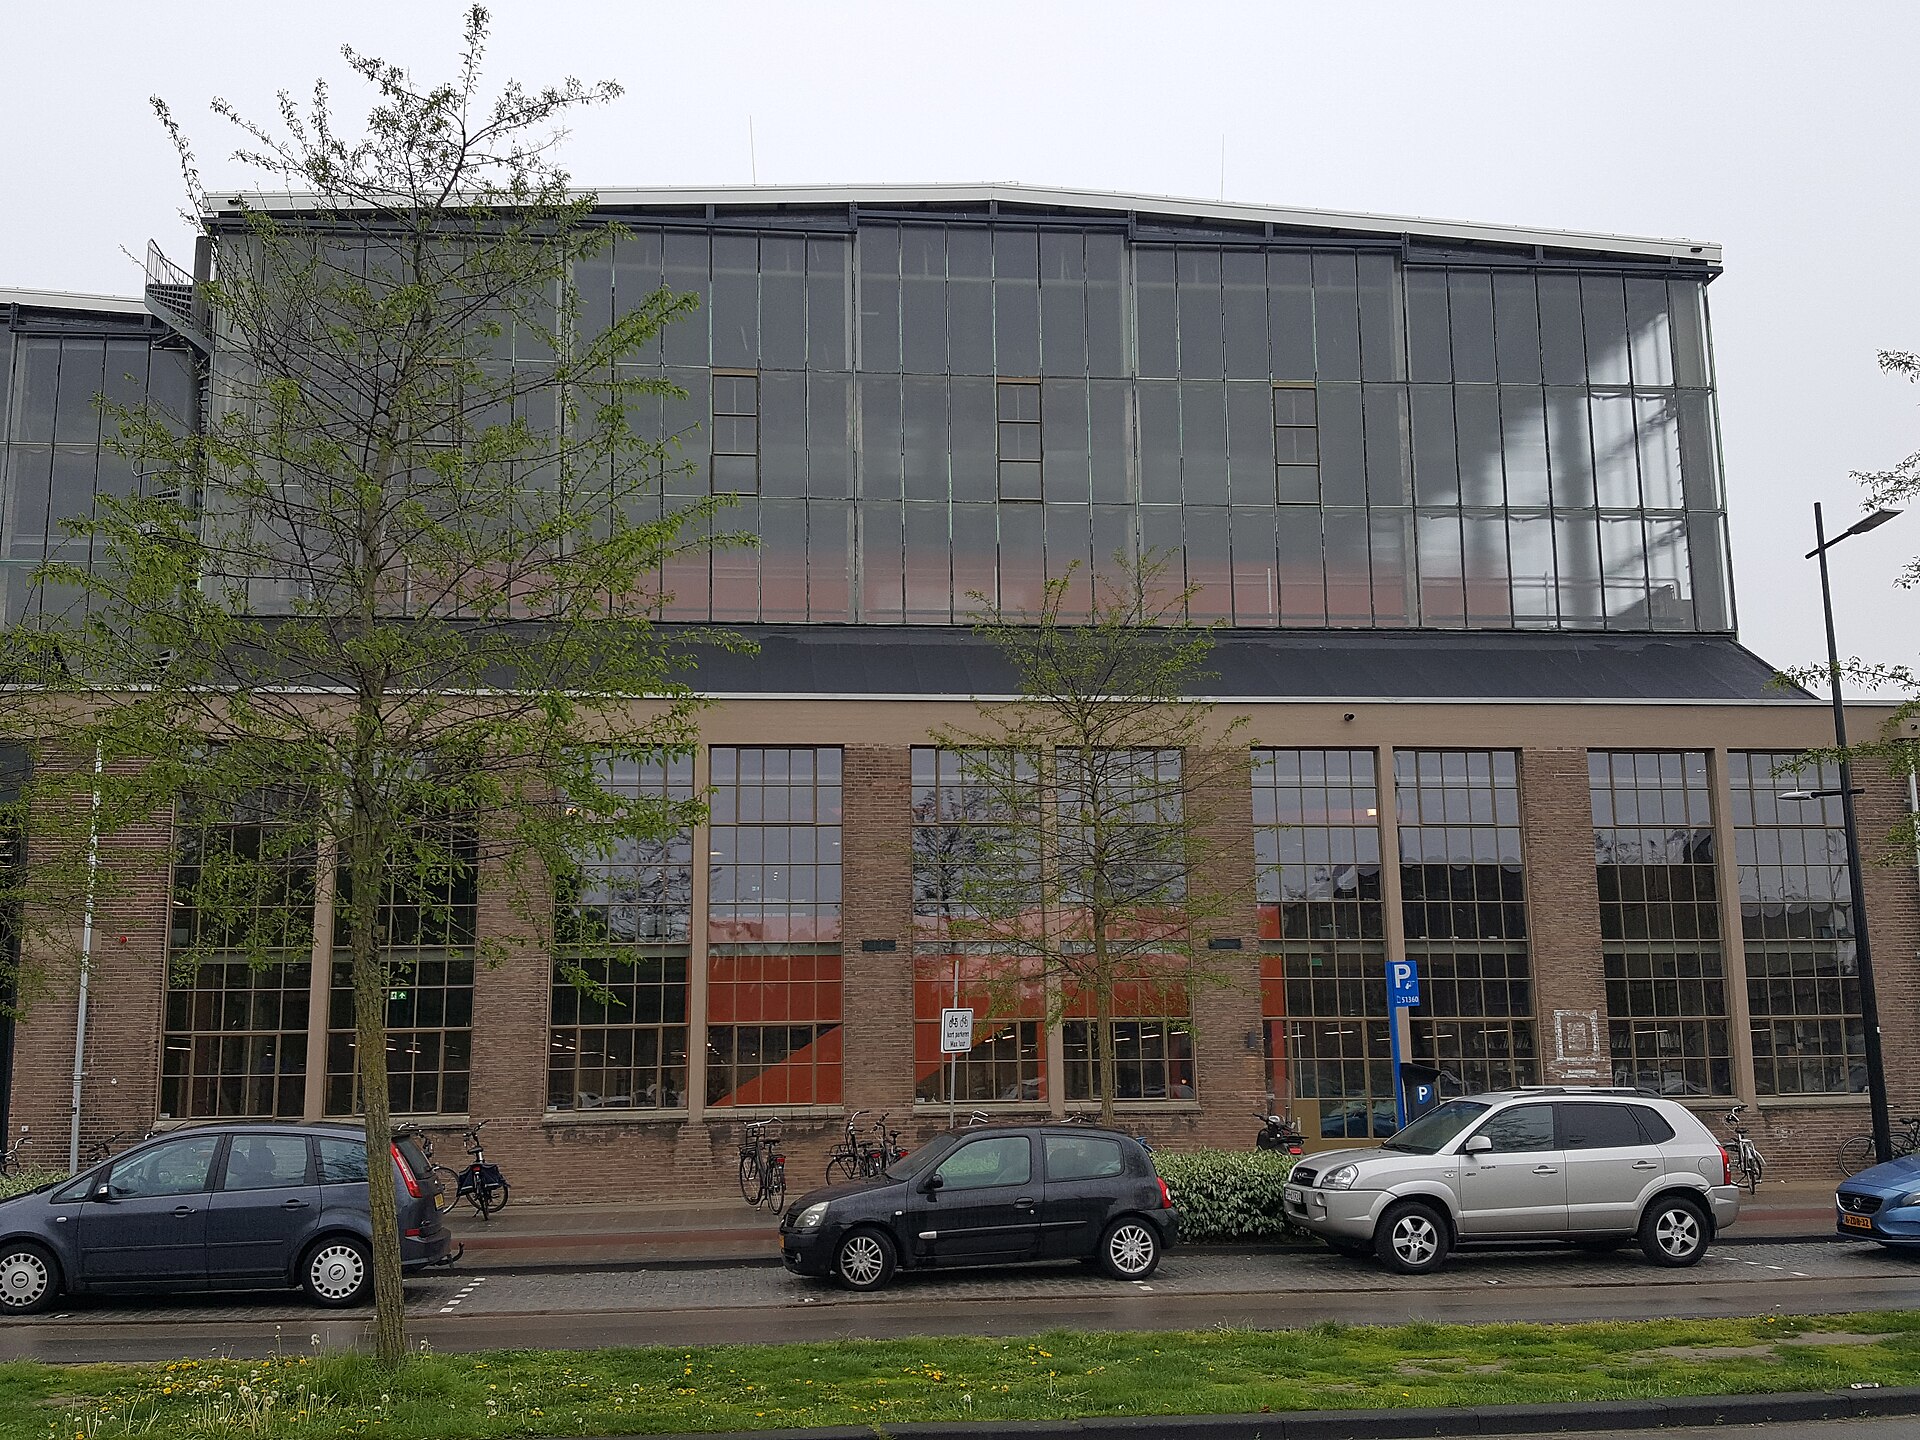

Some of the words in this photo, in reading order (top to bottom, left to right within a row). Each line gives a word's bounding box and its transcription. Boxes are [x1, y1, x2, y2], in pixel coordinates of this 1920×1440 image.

[1393, 964, 1411, 989] P
[1401, 996, 1419, 1004] 51360
[1418, 1086, 1428, 1101] P
